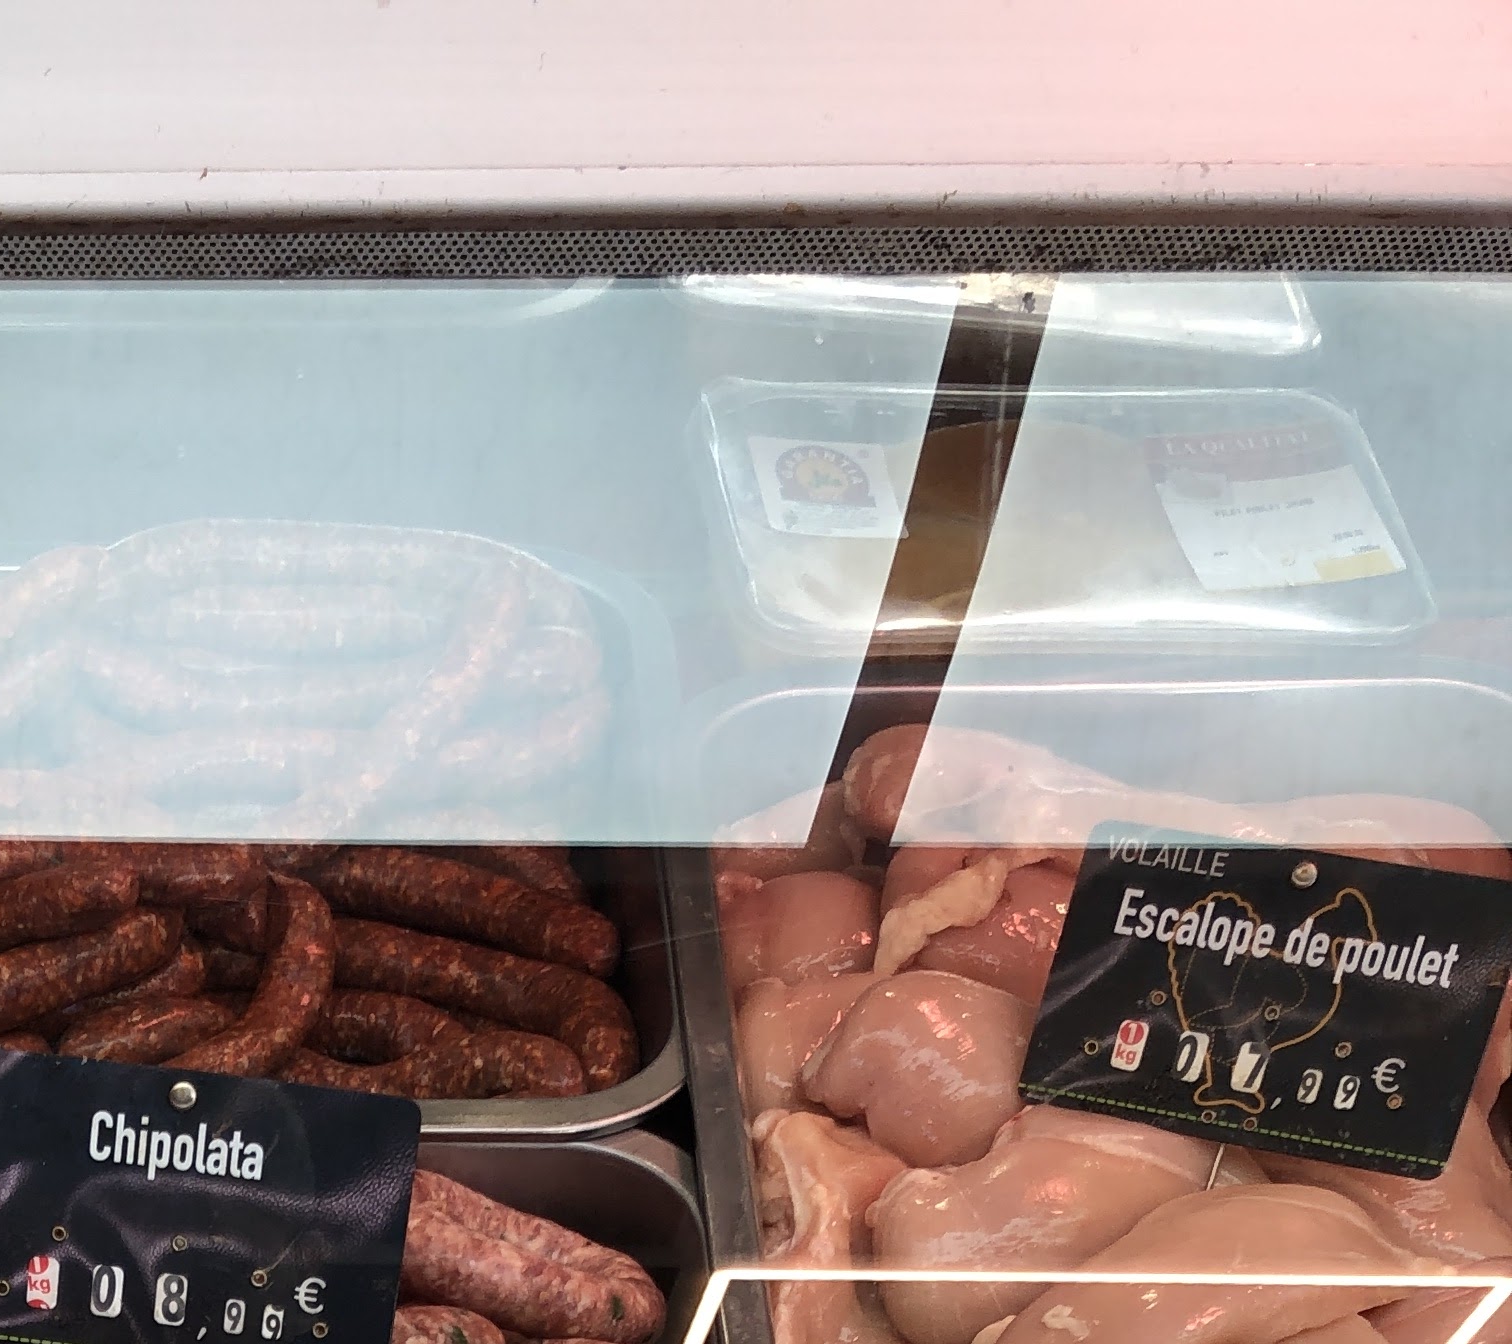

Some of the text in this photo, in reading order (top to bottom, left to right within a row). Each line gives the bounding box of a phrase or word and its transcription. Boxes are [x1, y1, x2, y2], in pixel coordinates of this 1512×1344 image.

[1108, 835, 1230, 878] VOLAILLE
[1114, 888, 1460, 989] Escalope de poulet
[1115, 1047, 1137, 1065] kg
[88, 1110, 265, 1181] Chipolata
[28, 1275, 51, 1293] kg
